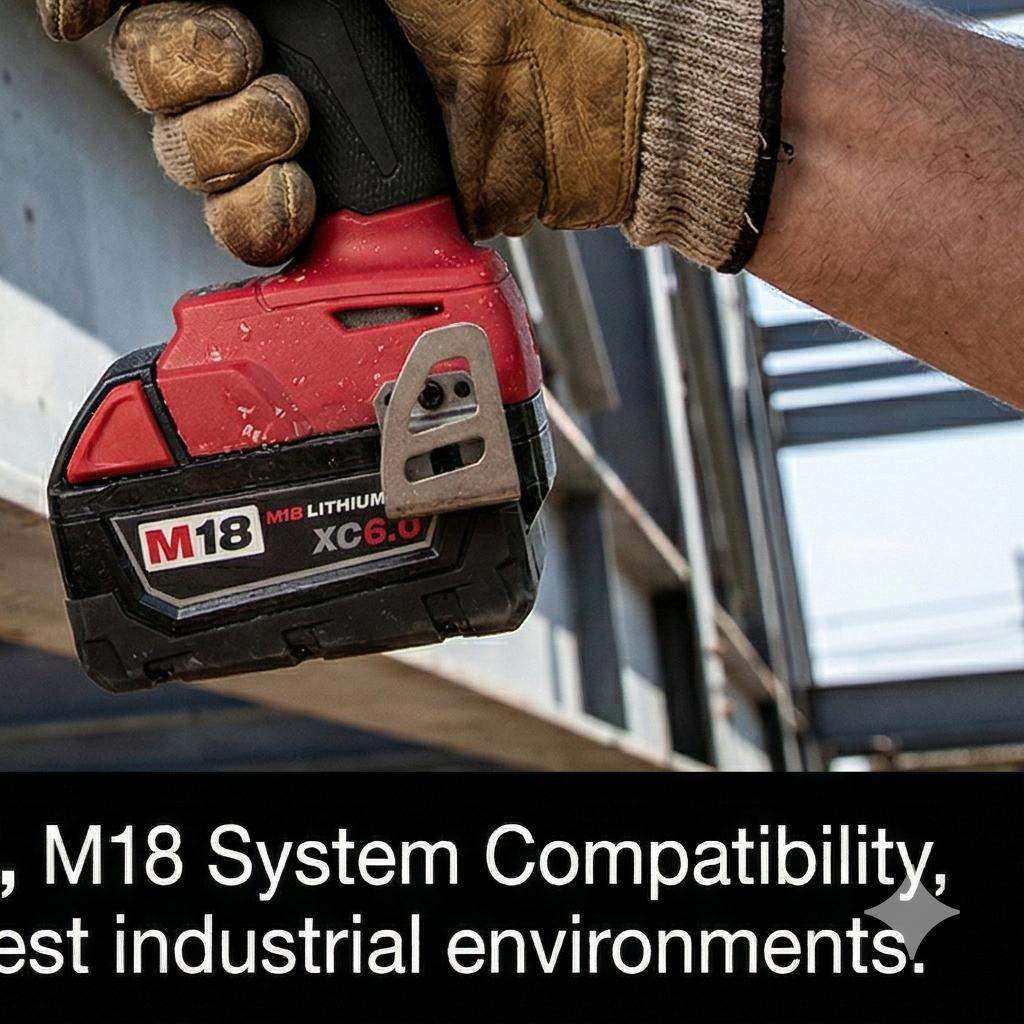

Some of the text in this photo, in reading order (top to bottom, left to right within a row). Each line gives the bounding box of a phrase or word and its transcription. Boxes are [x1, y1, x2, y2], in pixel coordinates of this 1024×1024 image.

[307, 491, 385, 518] LITHIUM
[144, 515, 253, 565] M18
[312, 517, 422, 555] XC6.0
